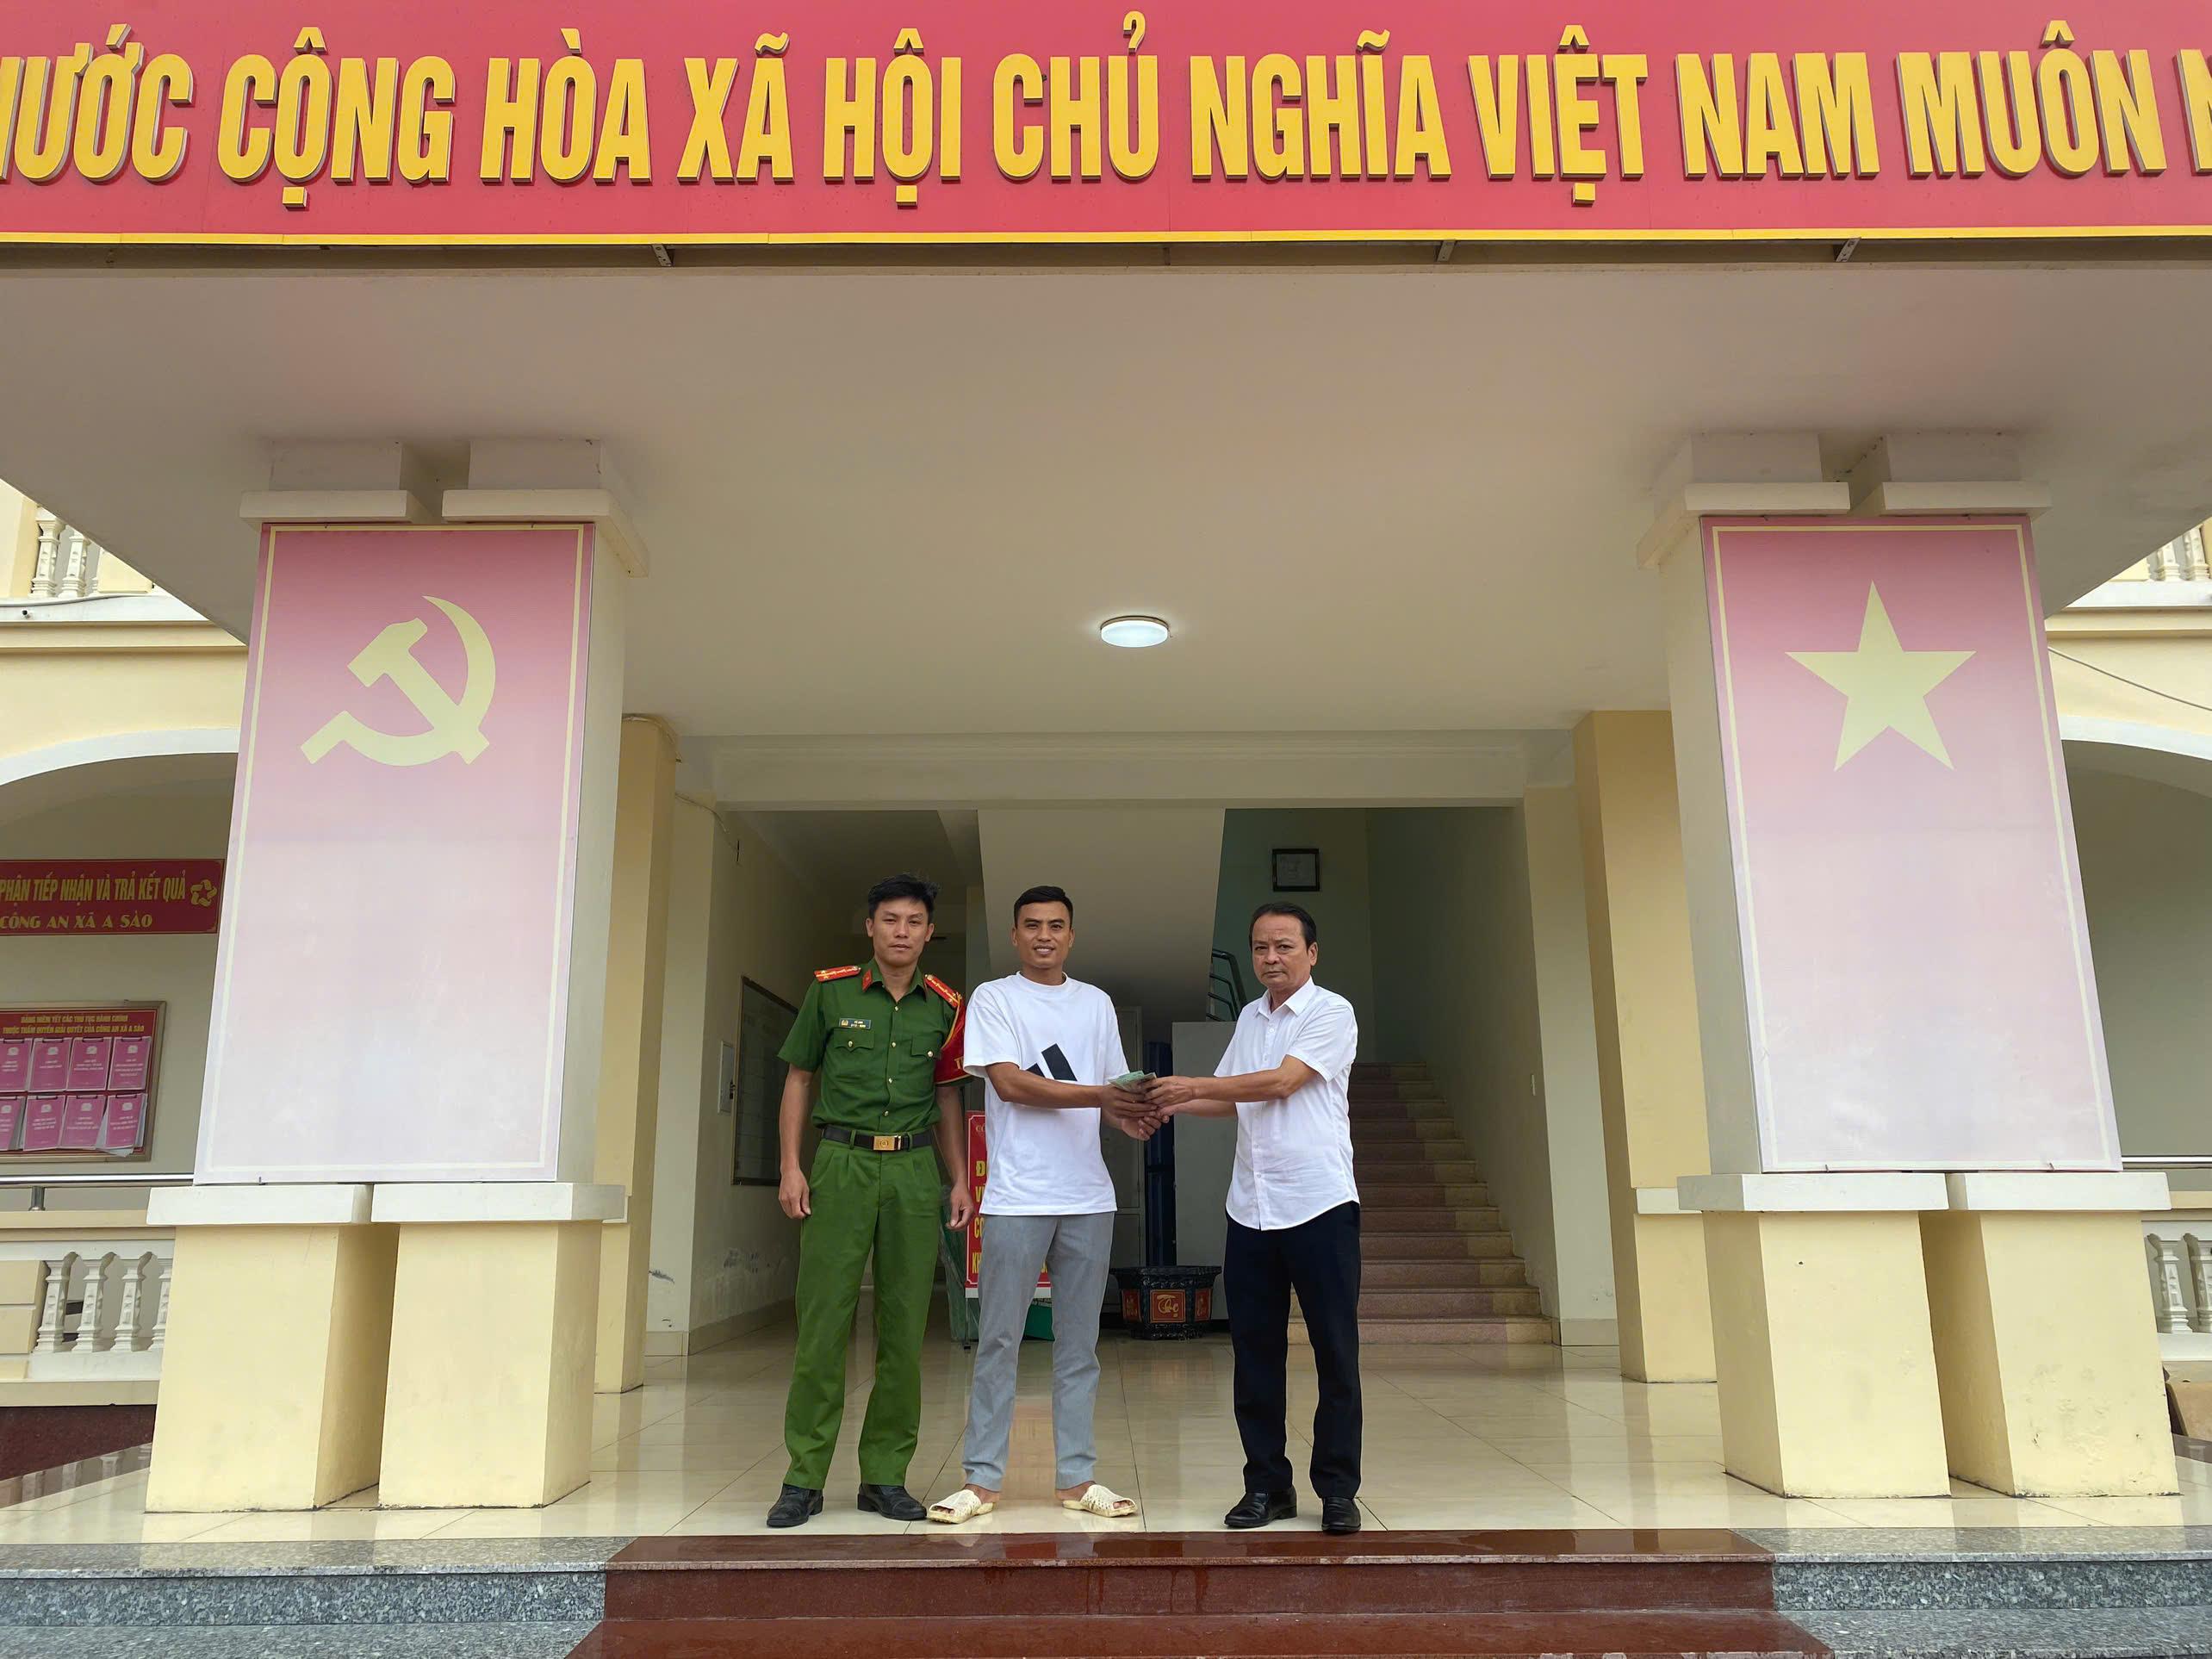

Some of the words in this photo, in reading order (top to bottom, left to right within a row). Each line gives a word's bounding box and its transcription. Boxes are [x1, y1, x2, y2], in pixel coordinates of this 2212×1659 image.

[218, 28, 456, 207] CỘNG
[480, 29, 652, 183] HÒA
[677, 34, 795, 181] XÃ
[823, 29, 963, 205] HỘI
[993, 12, 1160, 180] CHỦ
[1190, 31, 1453, 180] NGHĨA
[1469, 26, 1650, 203] VIỆT
[1676, 53, 1881, 177] NAM
[1898, 21, 2168, 176] MUÔN
[34, 871, 58, 901] TIẾP
[59, 873, 94, 906] NHẬN
[96, 873, 110, 901] VÀ
[115, 870, 135, 900] TRẢ
[138, 870, 161, 900] KẾT
[162, 869, 186, 902] QUẢ
[0, 911, 41, 929] CÔNG
[46, 916, 70, 929] AN
[74, 911, 96, 929] XÃ
[102, 915, 113, 928] A
